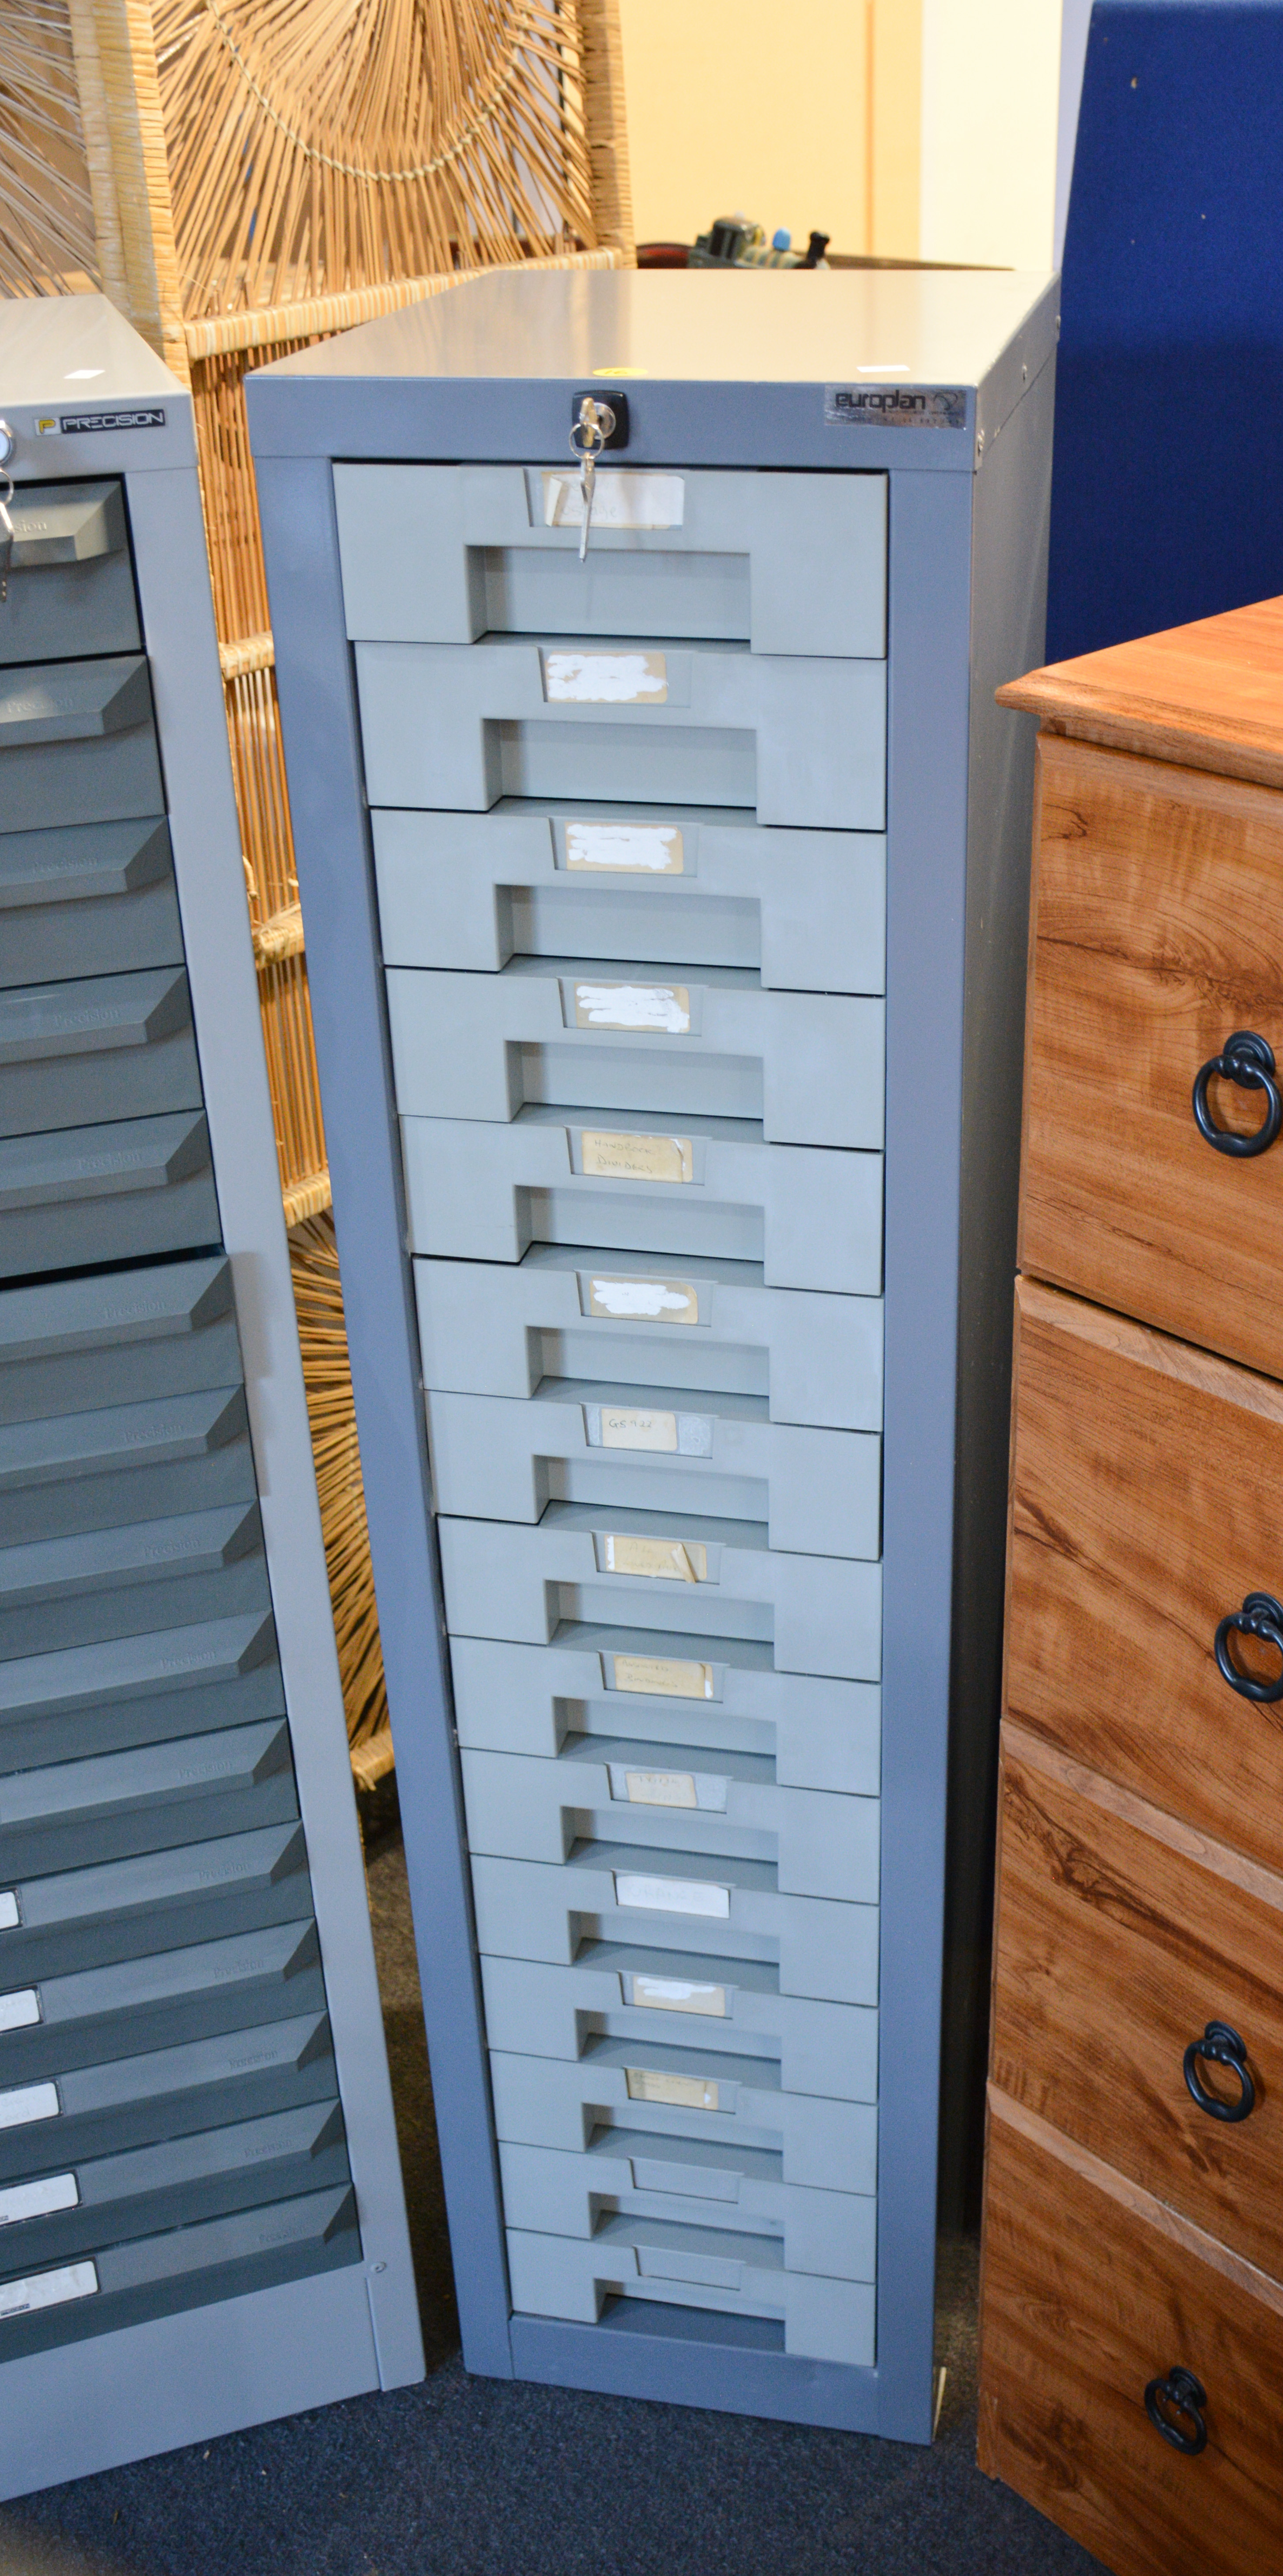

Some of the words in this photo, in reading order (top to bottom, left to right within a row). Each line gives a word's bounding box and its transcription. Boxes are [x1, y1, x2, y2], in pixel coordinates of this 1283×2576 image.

[835, 389, 925, 413] europlan
[64, 412, 163, 431] PRECISION
[32, 856, 98, 873] Precision
[53, 1008, 120, 1027] Precision
[77, 1150, 142, 1171] Precision
[104, 1299, 167, 1319] Precision
[123, 1422, 183, 1443] Precision
[143, 1538, 200, 1558] Precision
[160, 1650, 216, 1669] Precision
[179, 1760, 233, 1779] Precision
[198, 1861, 249, 1882] Precision
